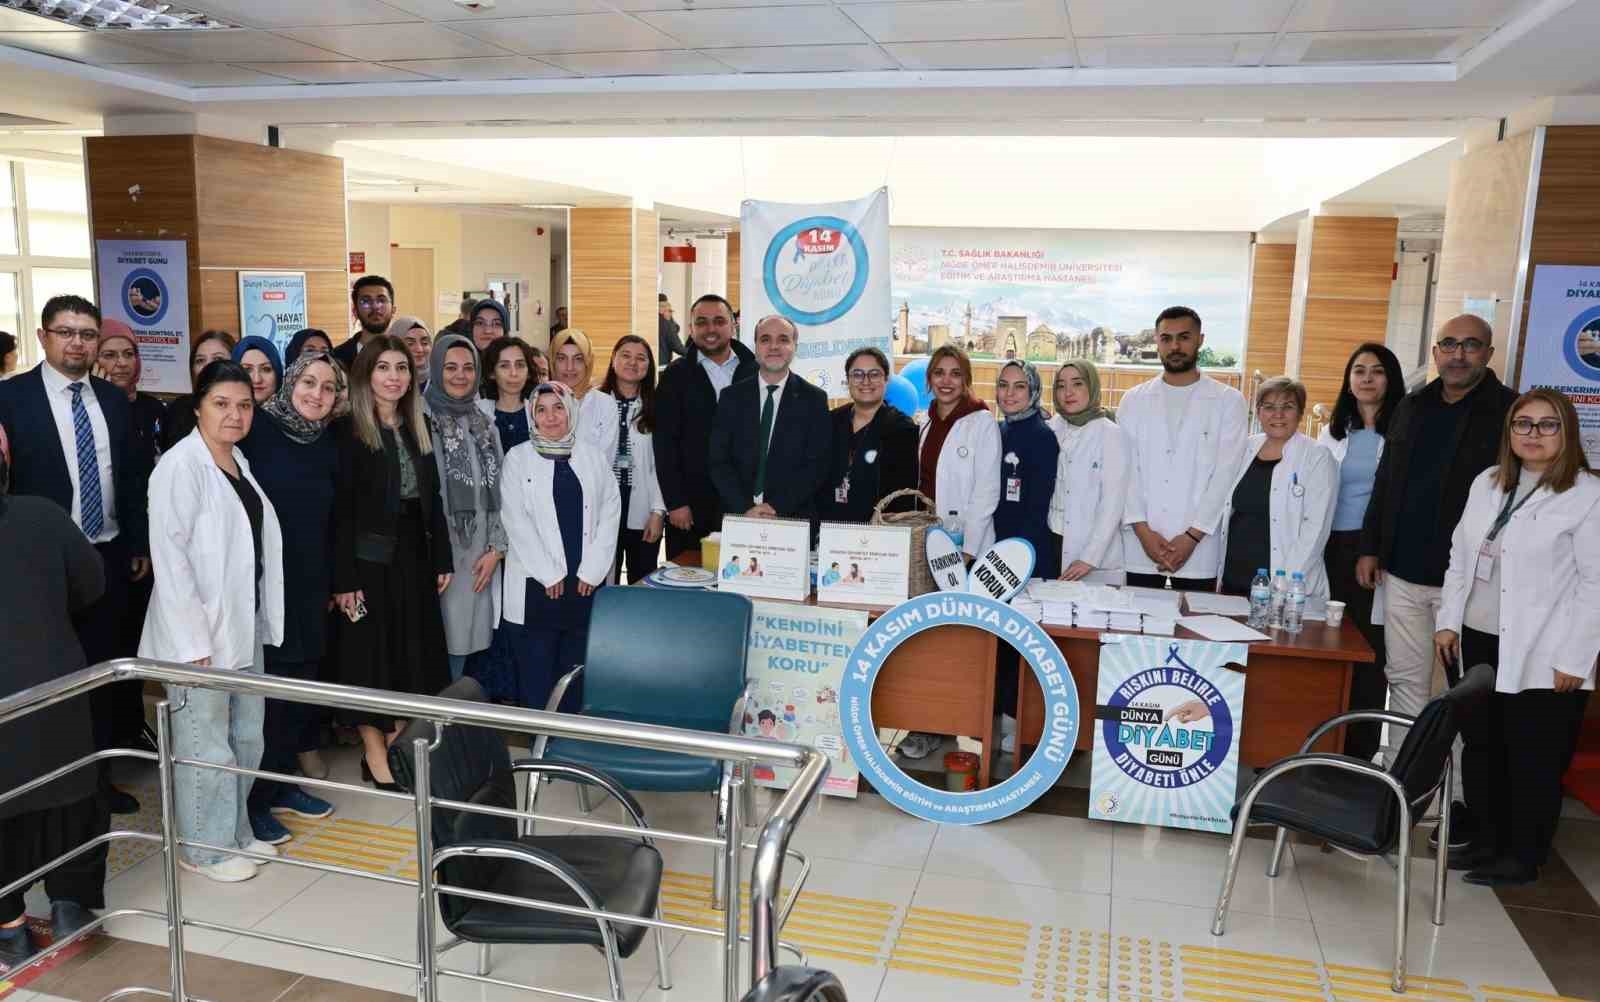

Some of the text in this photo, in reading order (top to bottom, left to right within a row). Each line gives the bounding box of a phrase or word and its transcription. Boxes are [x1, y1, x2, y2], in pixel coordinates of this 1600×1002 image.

[808, 229, 832, 243] 14
[803, 244, 834, 253] KASIM
[276, 313, 303, 324] HAYAT
[930, 551, 962, 572] FARKINDA
[985, 550, 1022, 589] DİYABETTEN
[947, 571, 959, 587] OL
[974, 564, 1008, 599] KORUN
[853, 597, 1073, 764] 14 KASIM DÜNYA DİYABET GÜNÜ
[1120, 709, 1160, 722] DÜNYA
[1117, 722, 1217, 753] DİYABET
[1149, 752, 1181, 765] GÜNÜ
[1178, 759, 1215, 786] ÖNLE
